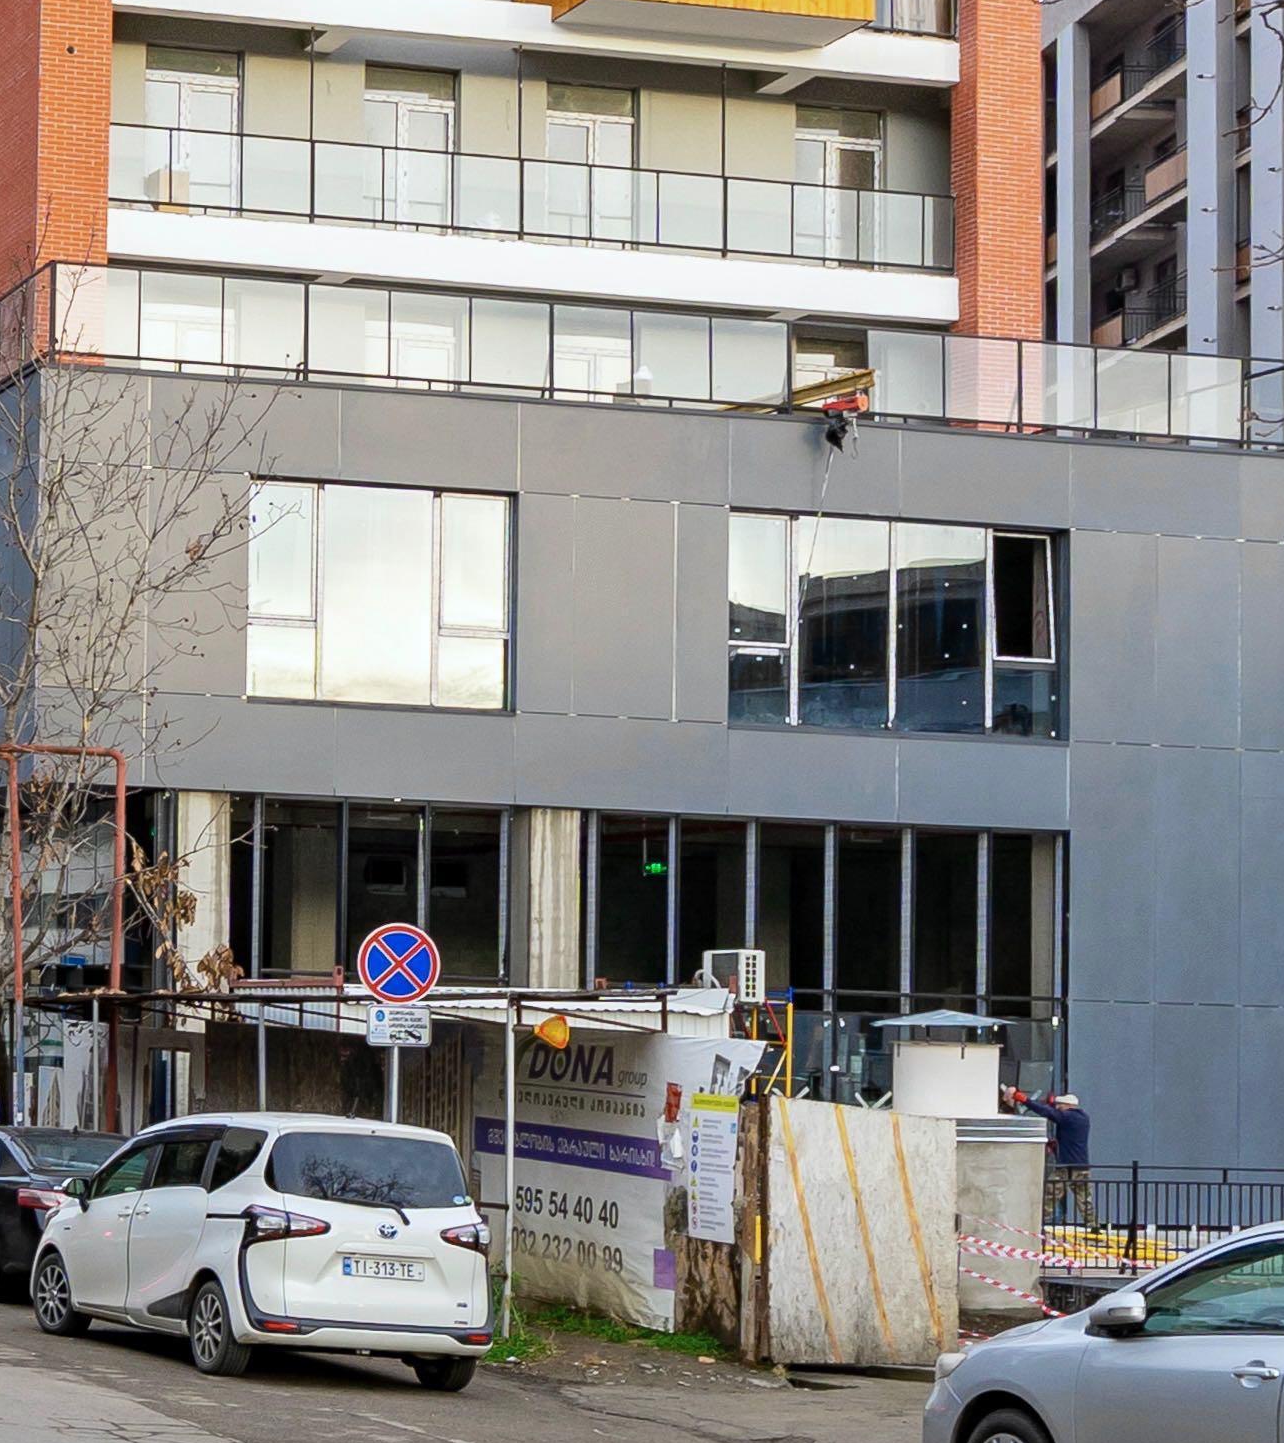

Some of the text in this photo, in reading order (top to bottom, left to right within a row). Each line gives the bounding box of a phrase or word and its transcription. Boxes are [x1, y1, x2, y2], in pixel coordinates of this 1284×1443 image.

[528, 1042, 648, 1089] DONA group
[516, 1186, 619, 1229] 595 54 40 40
[354, 1259, 415, 1278] TI-313-TE
[512, 1226, 536, 1256] 032
[542, 1233, 572, 1263] 232
[578, 1240, 597, 1269] 00
